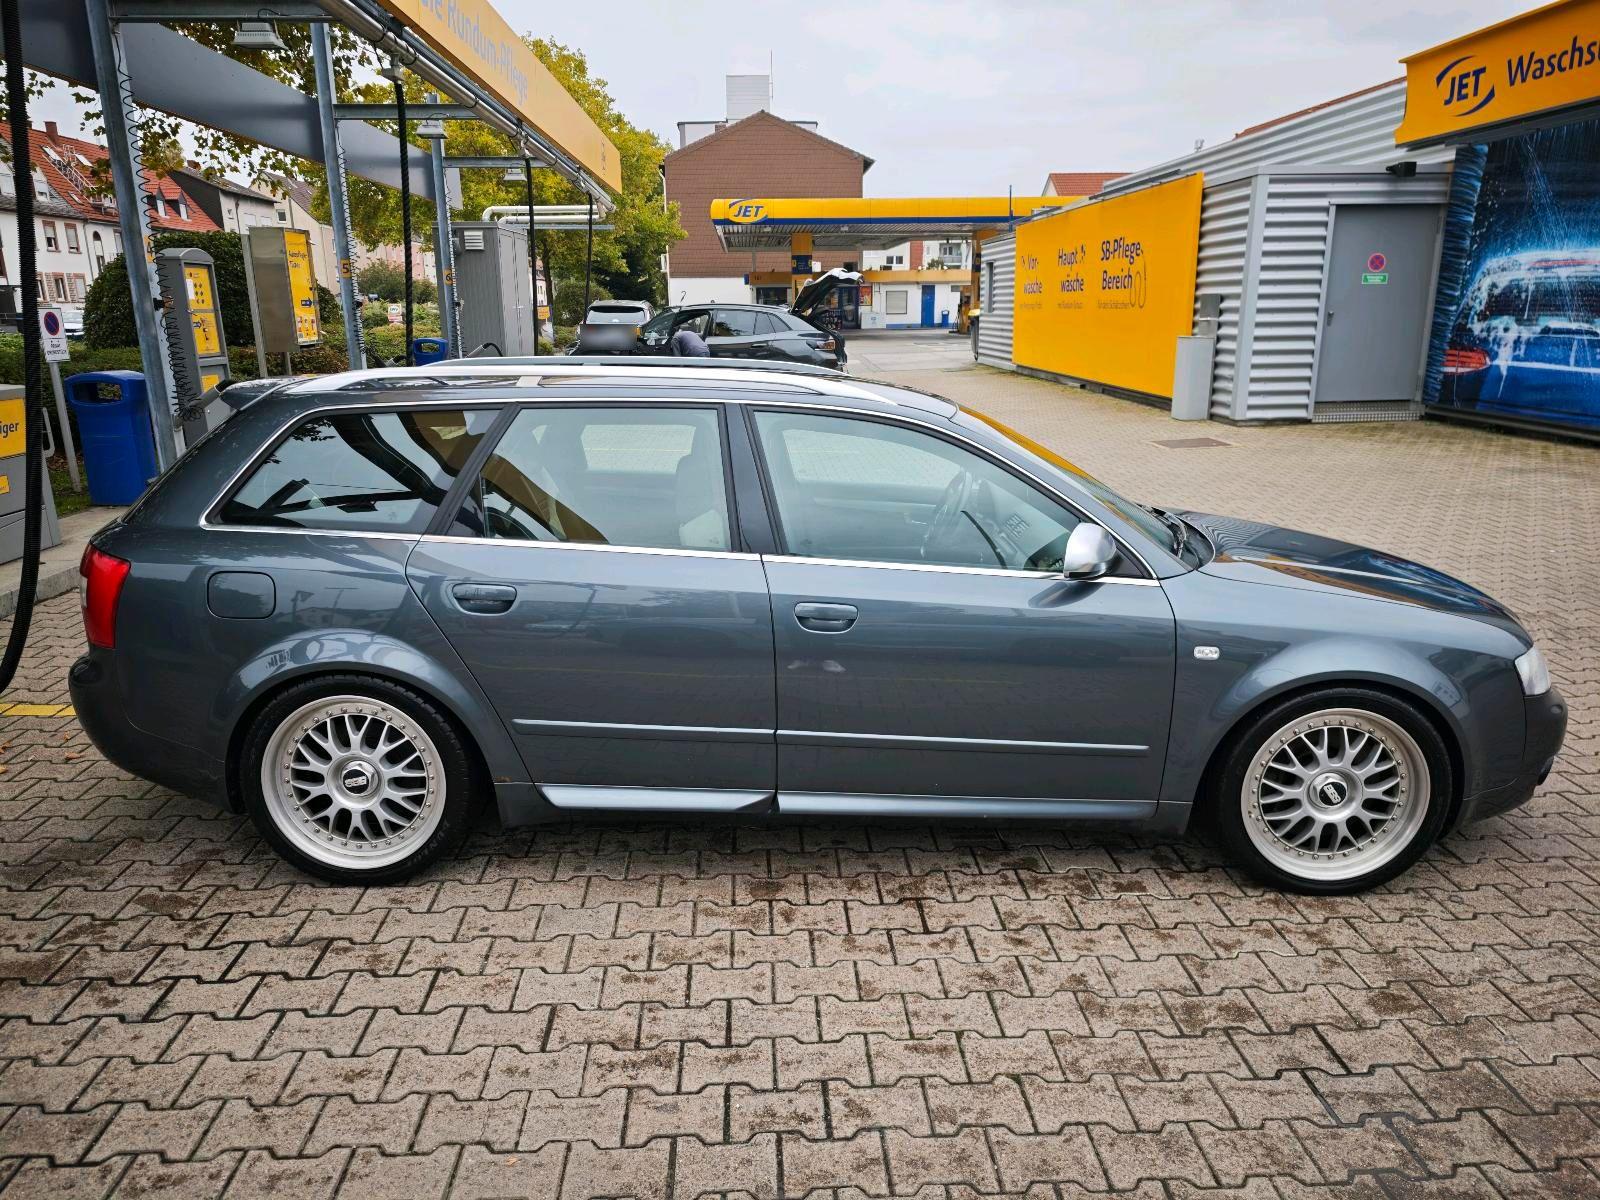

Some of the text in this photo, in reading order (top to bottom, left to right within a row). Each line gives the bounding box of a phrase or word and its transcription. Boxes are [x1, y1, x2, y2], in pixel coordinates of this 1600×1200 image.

[1507, 35, 1600, 87] Waschs
[1443, 66, 1487, 106] JET
[733, 205, 764, 218] JET
[342, 263, 350, 274] 5
[1101, 267, 1133, 290] Bereich
[1060, 272, 1084, 293] wäsche
[1323, 784, 1342, 804] BBS
